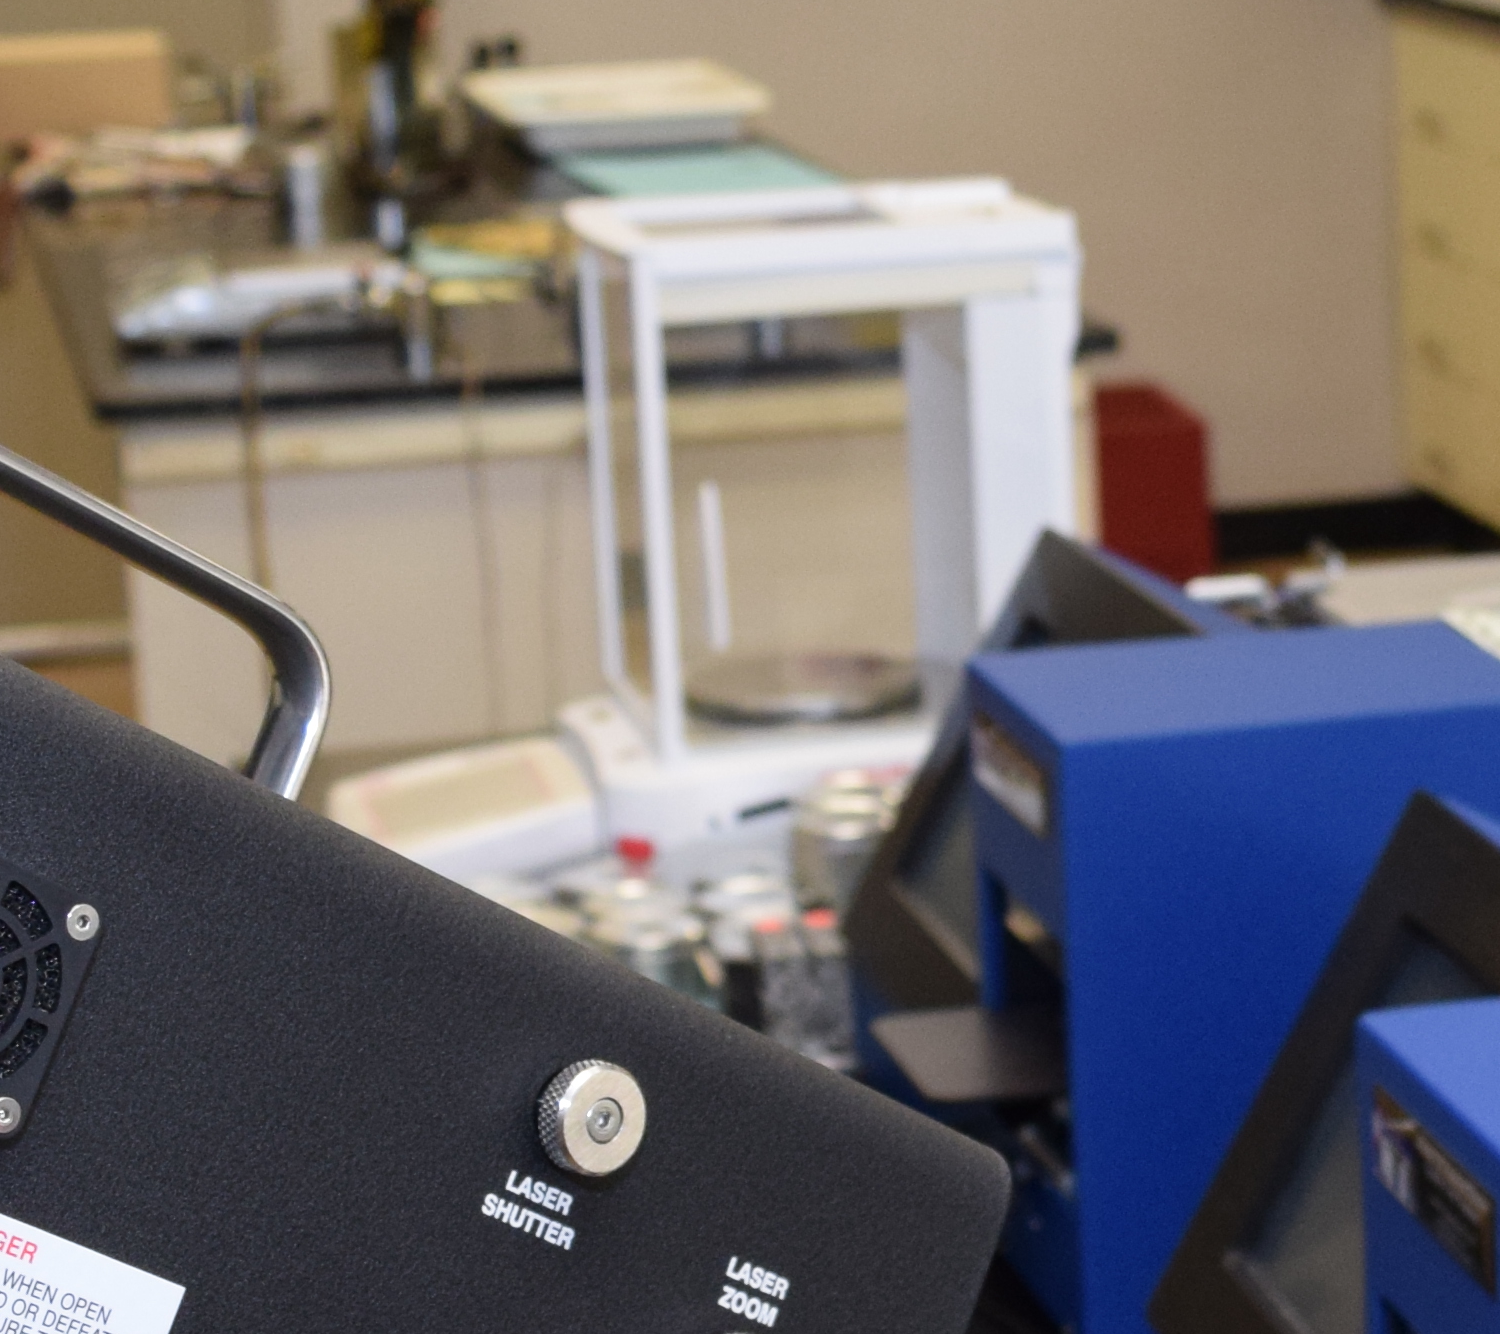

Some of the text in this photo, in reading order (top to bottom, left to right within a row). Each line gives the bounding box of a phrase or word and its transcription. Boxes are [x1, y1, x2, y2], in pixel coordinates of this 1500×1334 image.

[506, 1170, 574, 1216] LASER
[481, 1194, 575, 1250] SHUTTER
[3, 1269, 58, 1304] WHEN
[60, 1292, 112, 1326] OPEN
[726, 1256, 790, 1300] LASER
[11, 1297, 39, 1322] OR
[718, 1285, 778, 1328] ZOOM
